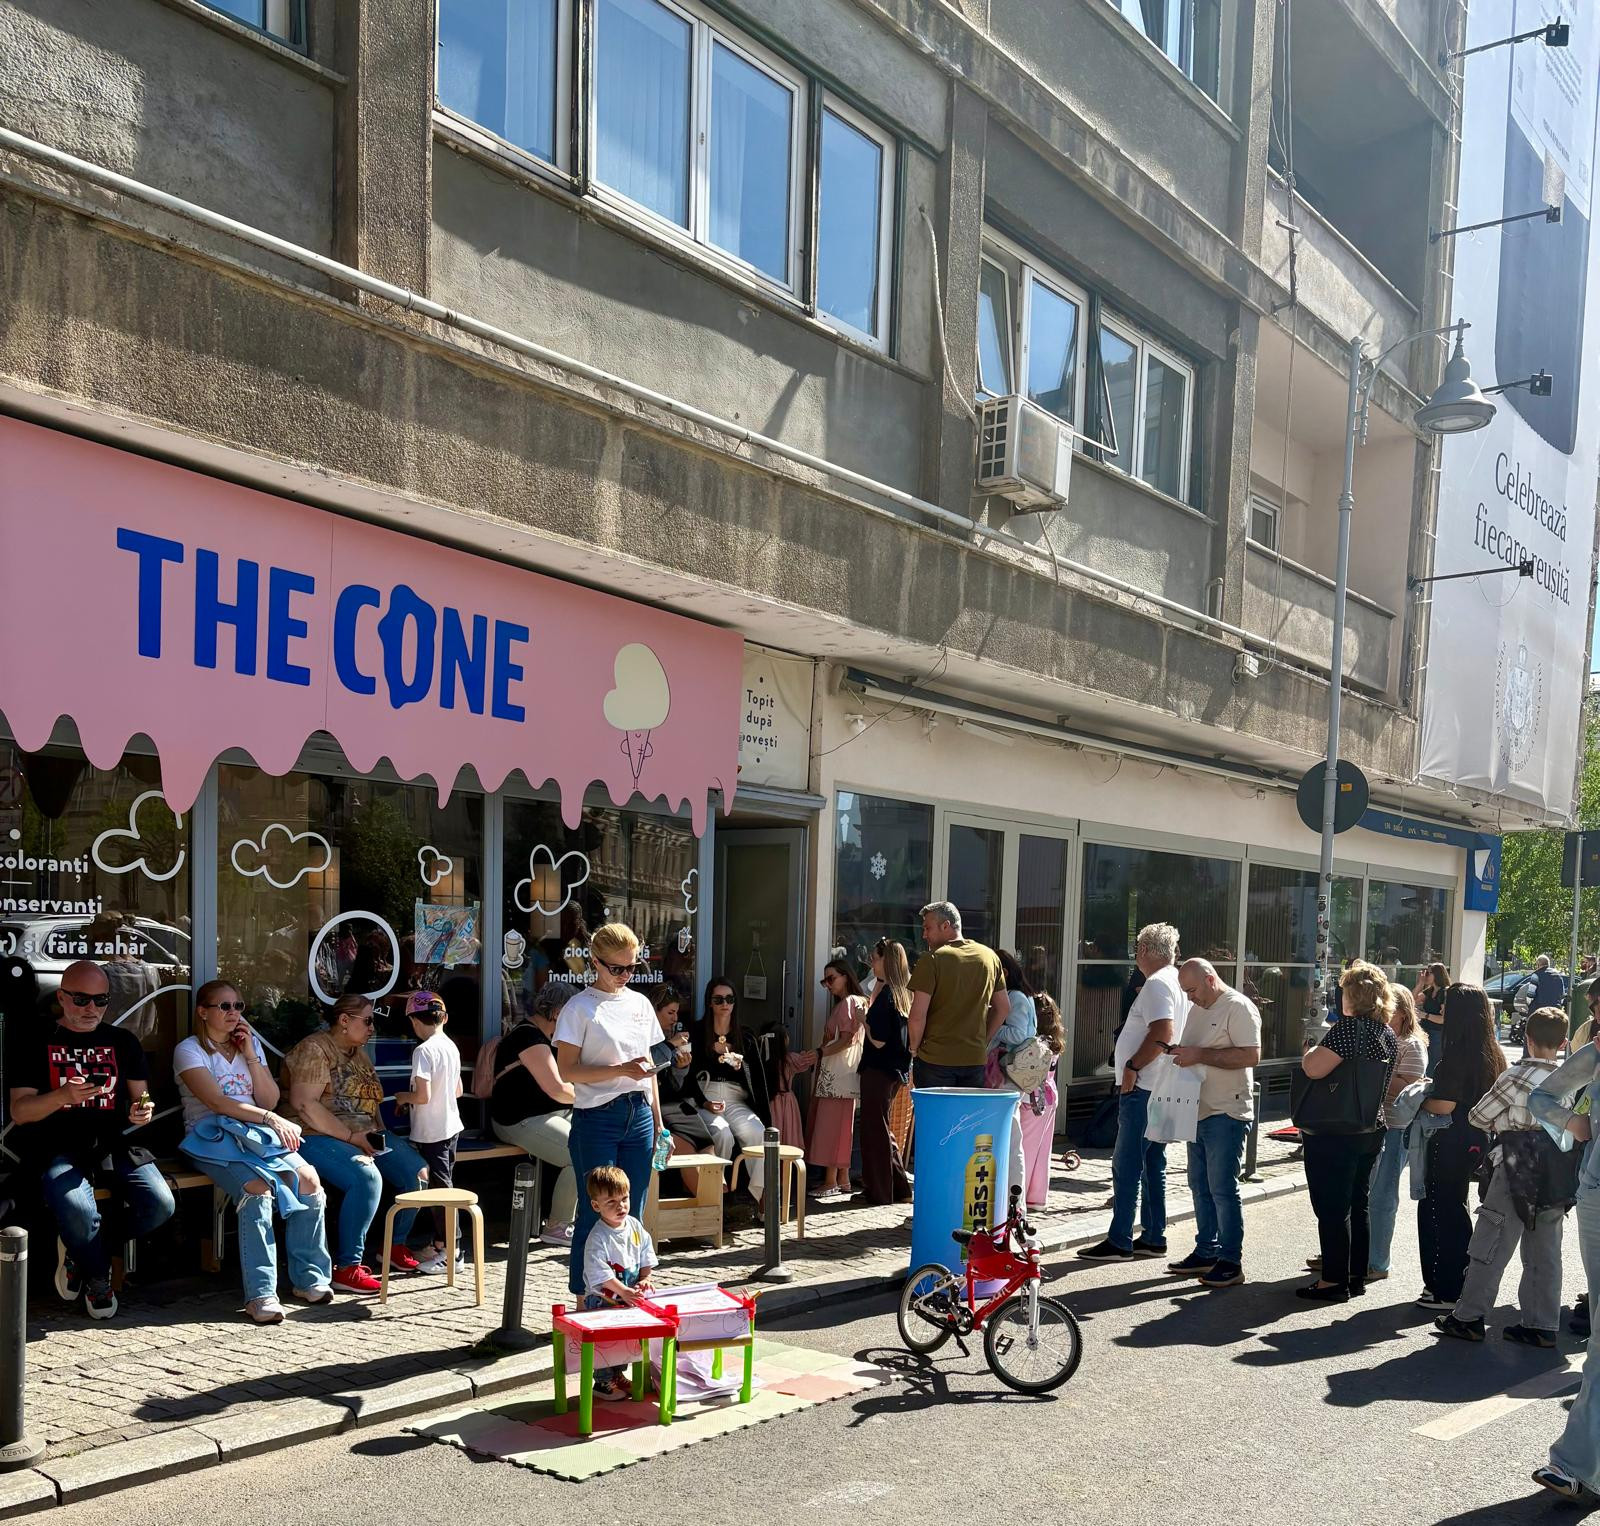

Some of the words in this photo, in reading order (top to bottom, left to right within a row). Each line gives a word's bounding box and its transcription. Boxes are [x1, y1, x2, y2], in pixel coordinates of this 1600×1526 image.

[1495, 452, 1568, 542] Celebrează
[116, 527, 315, 686] THE
[333, 584, 530, 723] CONE
[746, 689, 775, 710] Topit
[746, 710, 772, 730] după
[742, 734, 778, 752] ovești
[0, 895, 102, 923] nservanți
[48, 933, 88, 954] fără
[94, 934, 148, 955] zahăr
